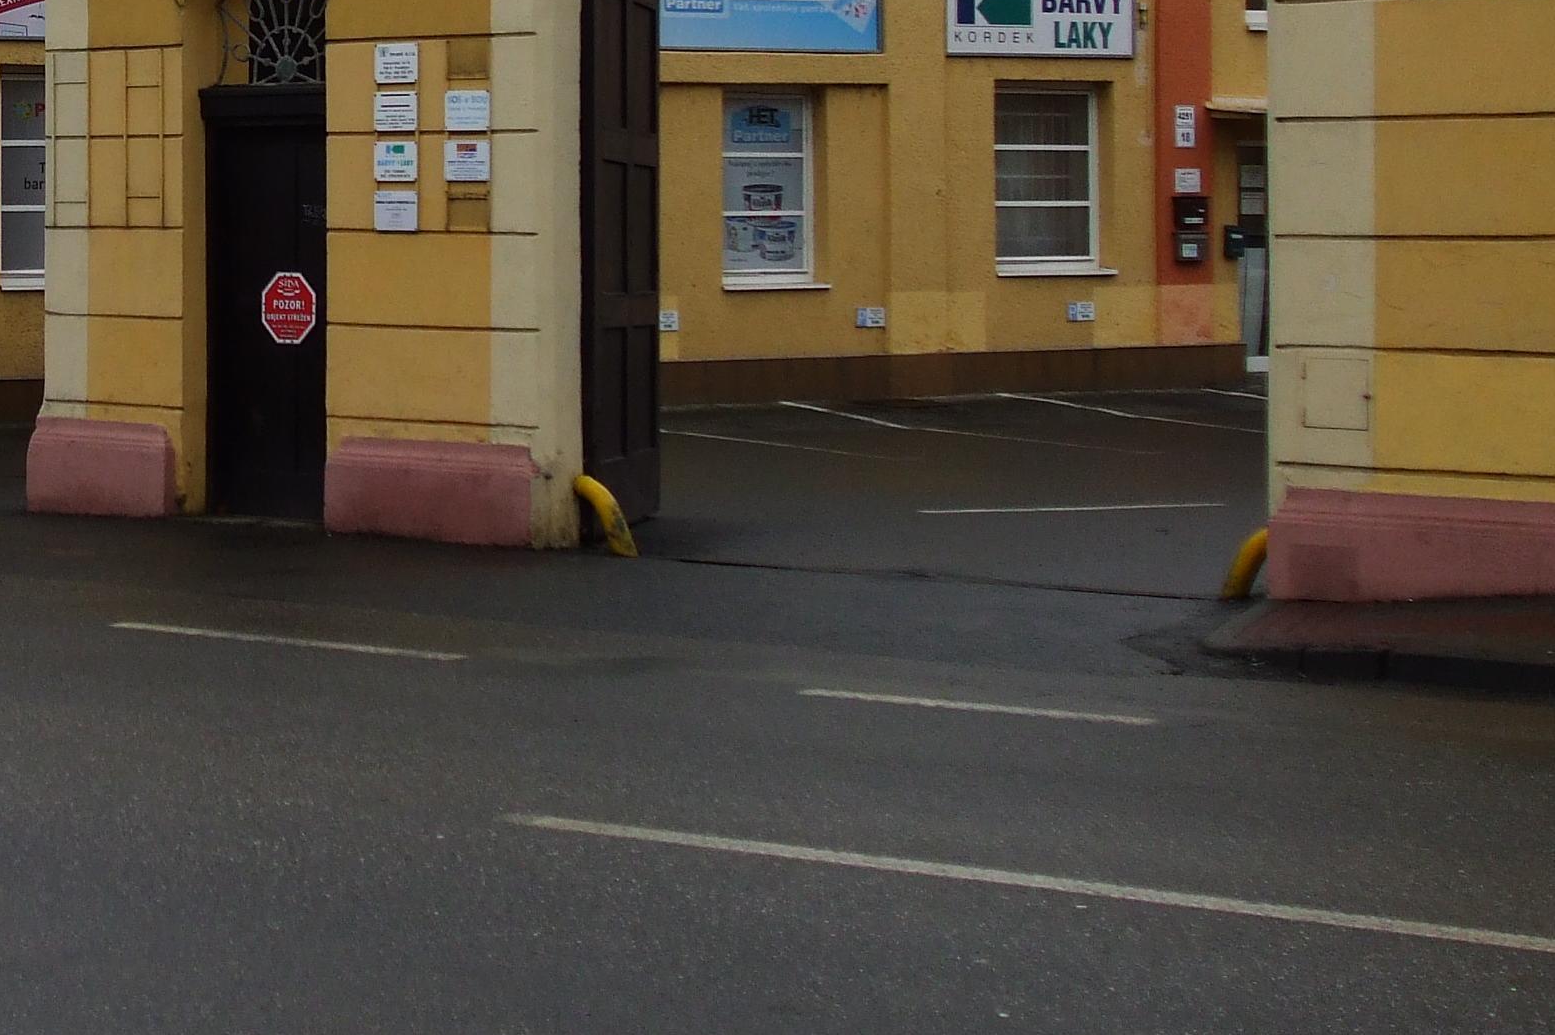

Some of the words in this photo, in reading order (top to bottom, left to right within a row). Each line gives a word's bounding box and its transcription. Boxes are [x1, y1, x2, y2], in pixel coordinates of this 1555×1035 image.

[954, 31, 1034, 44] KORDEK
[1054, 21, 1113, 49] LAKY
[733, 130, 789, 142] Partner
[273, 300, 305, 310] POZOR!
